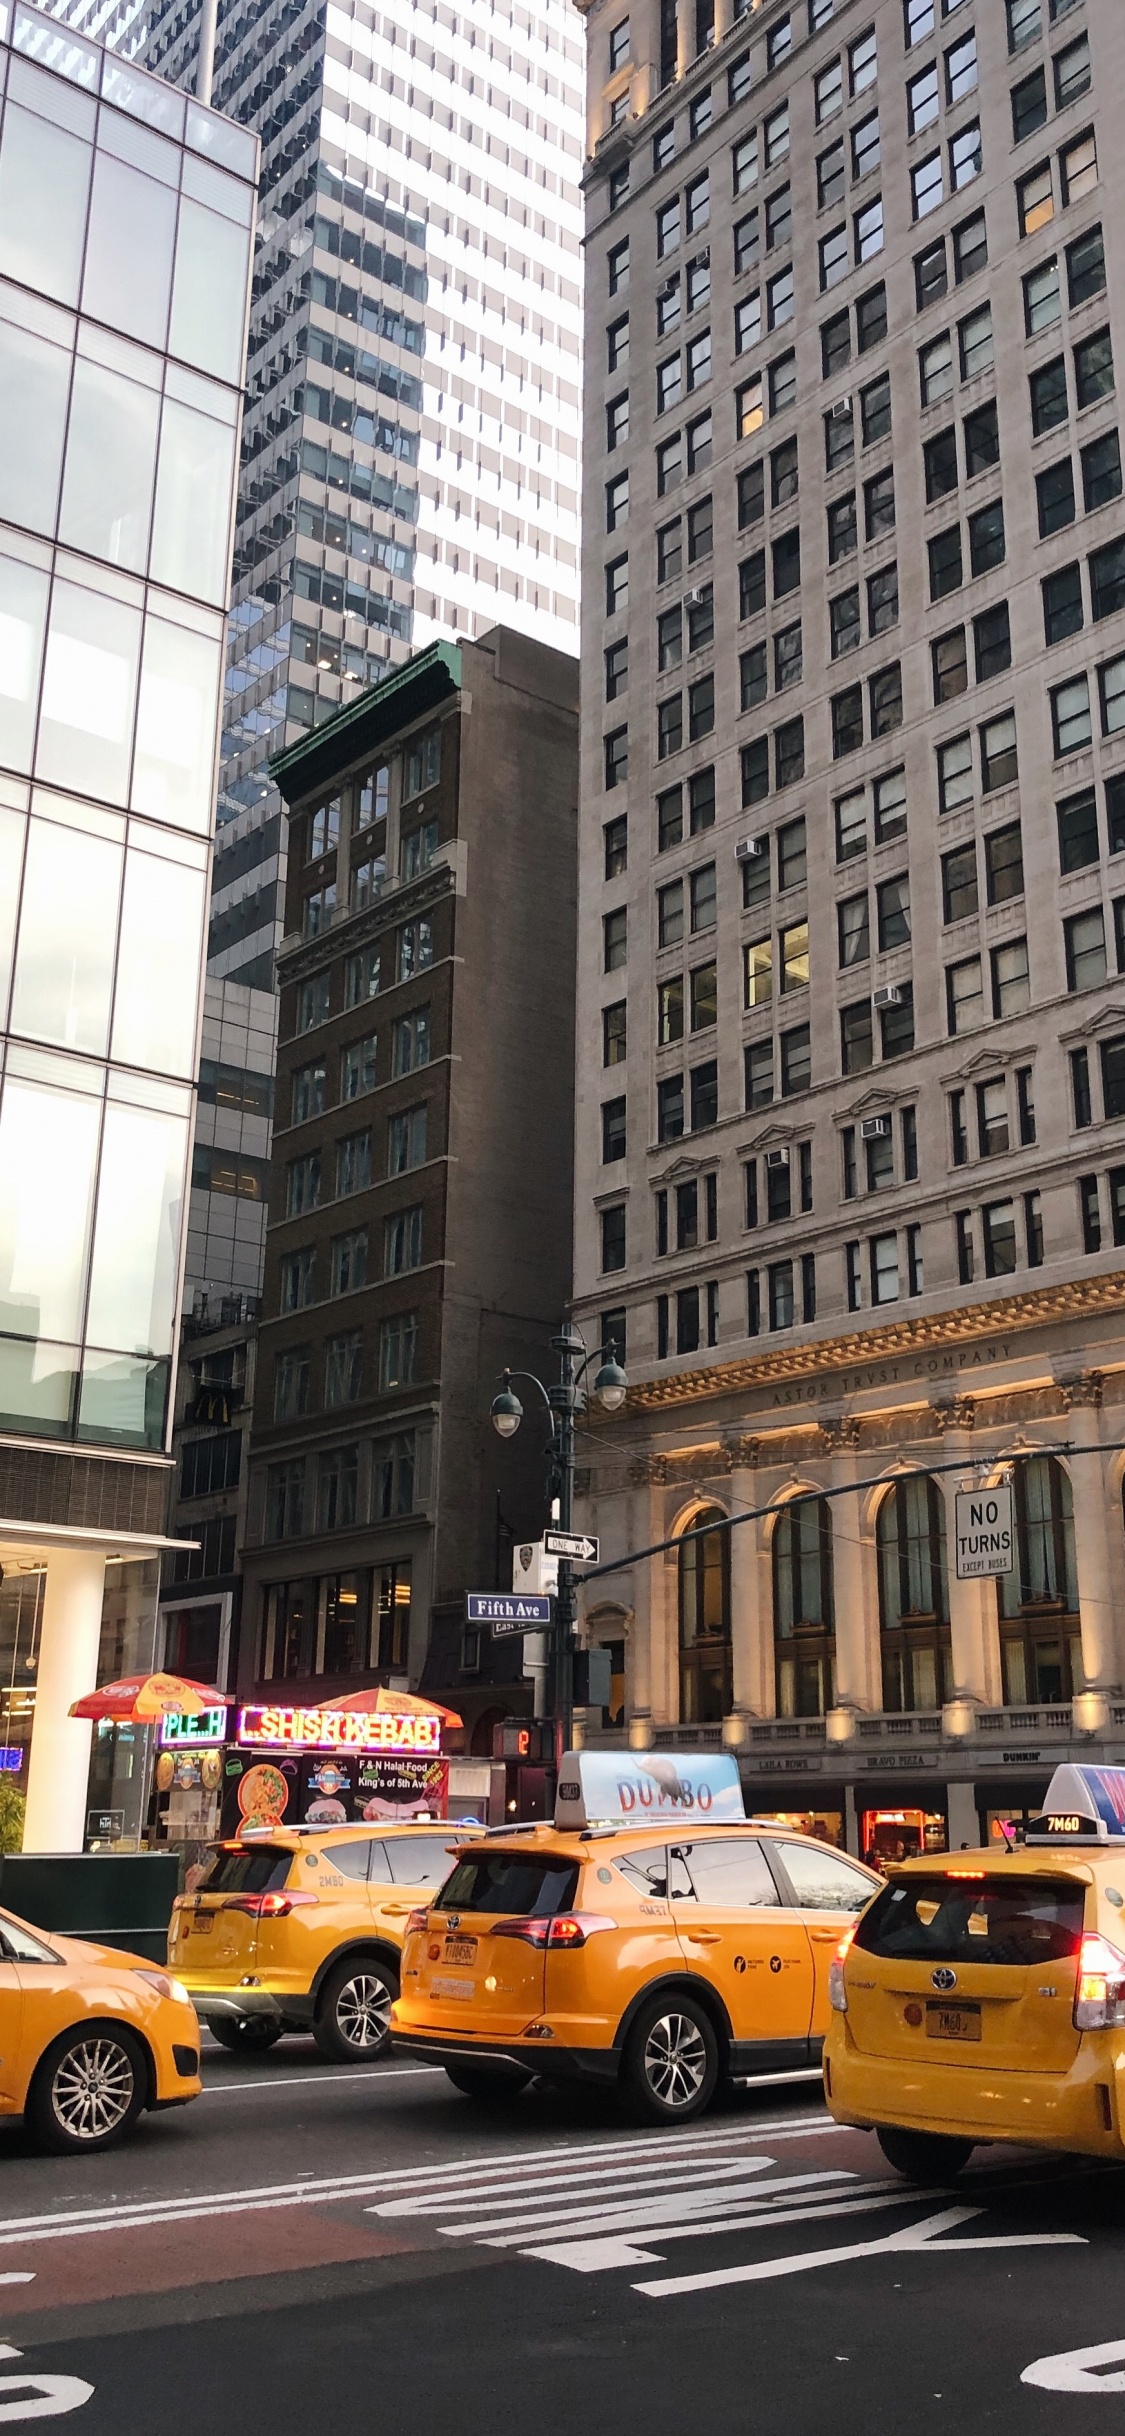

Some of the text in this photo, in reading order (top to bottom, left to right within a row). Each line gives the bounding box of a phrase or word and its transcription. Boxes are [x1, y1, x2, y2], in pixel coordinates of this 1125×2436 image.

[772, 1384, 829, 1406] ASTOR
[914, 1343, 1012, 1376] COMPANY
[970, 1501, 998, 1527] NO
[552, 1539, 591, 1554] ONE WAY
[958, 1531, 1010, 1556] TURNS
[962, 1557, 1007, 1573] EXCEPT BUSES
[343, 1713, 432, 1746] KEBAB
[867, 1755, 925, 1767] BRAVO PIZZA
[1003, 1752, 1040, 1763] DUNKIN'
[359, 1760, 366, 1770] F
[367, 1760, 374, 1770] &
[375, 1760, 382, 1770] N
[384, 1761, 405, 1771] Halal
[406, 1762, 428, 1772] Food
[421, 1760, 441, 1782] SINCE
[358, 1777, 385, 1789] King's
[386, 1778, 396, 1788] of
[397, 1778, 410, 1788] 5th
[412, 1778, 428, 1789] Ave
[1047, 1817, 1080, 1832] 7M60
